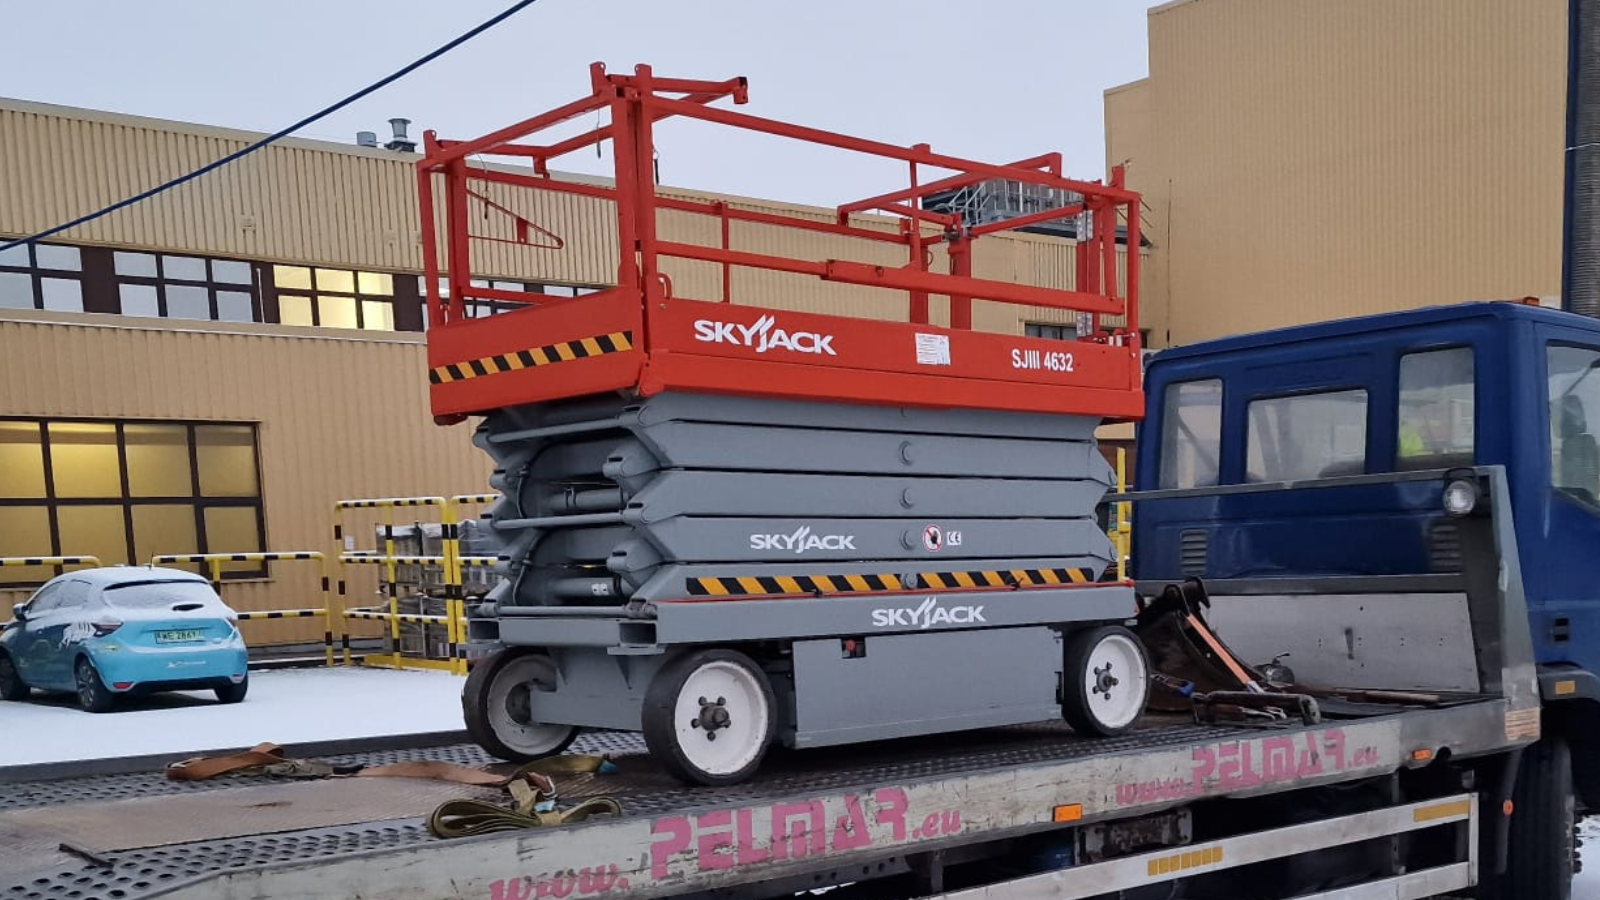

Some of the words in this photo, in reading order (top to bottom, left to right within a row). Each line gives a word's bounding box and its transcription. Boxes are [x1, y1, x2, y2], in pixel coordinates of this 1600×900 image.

[693, 313, 837, 356] SKYJACK
[1012, 348, 1040, 370] SJIII
[1043, 351, 1074, 372] 4632
[750, 525, 857, 554] SKYJACK
[871, 595, 987, 629] SKYJACK
